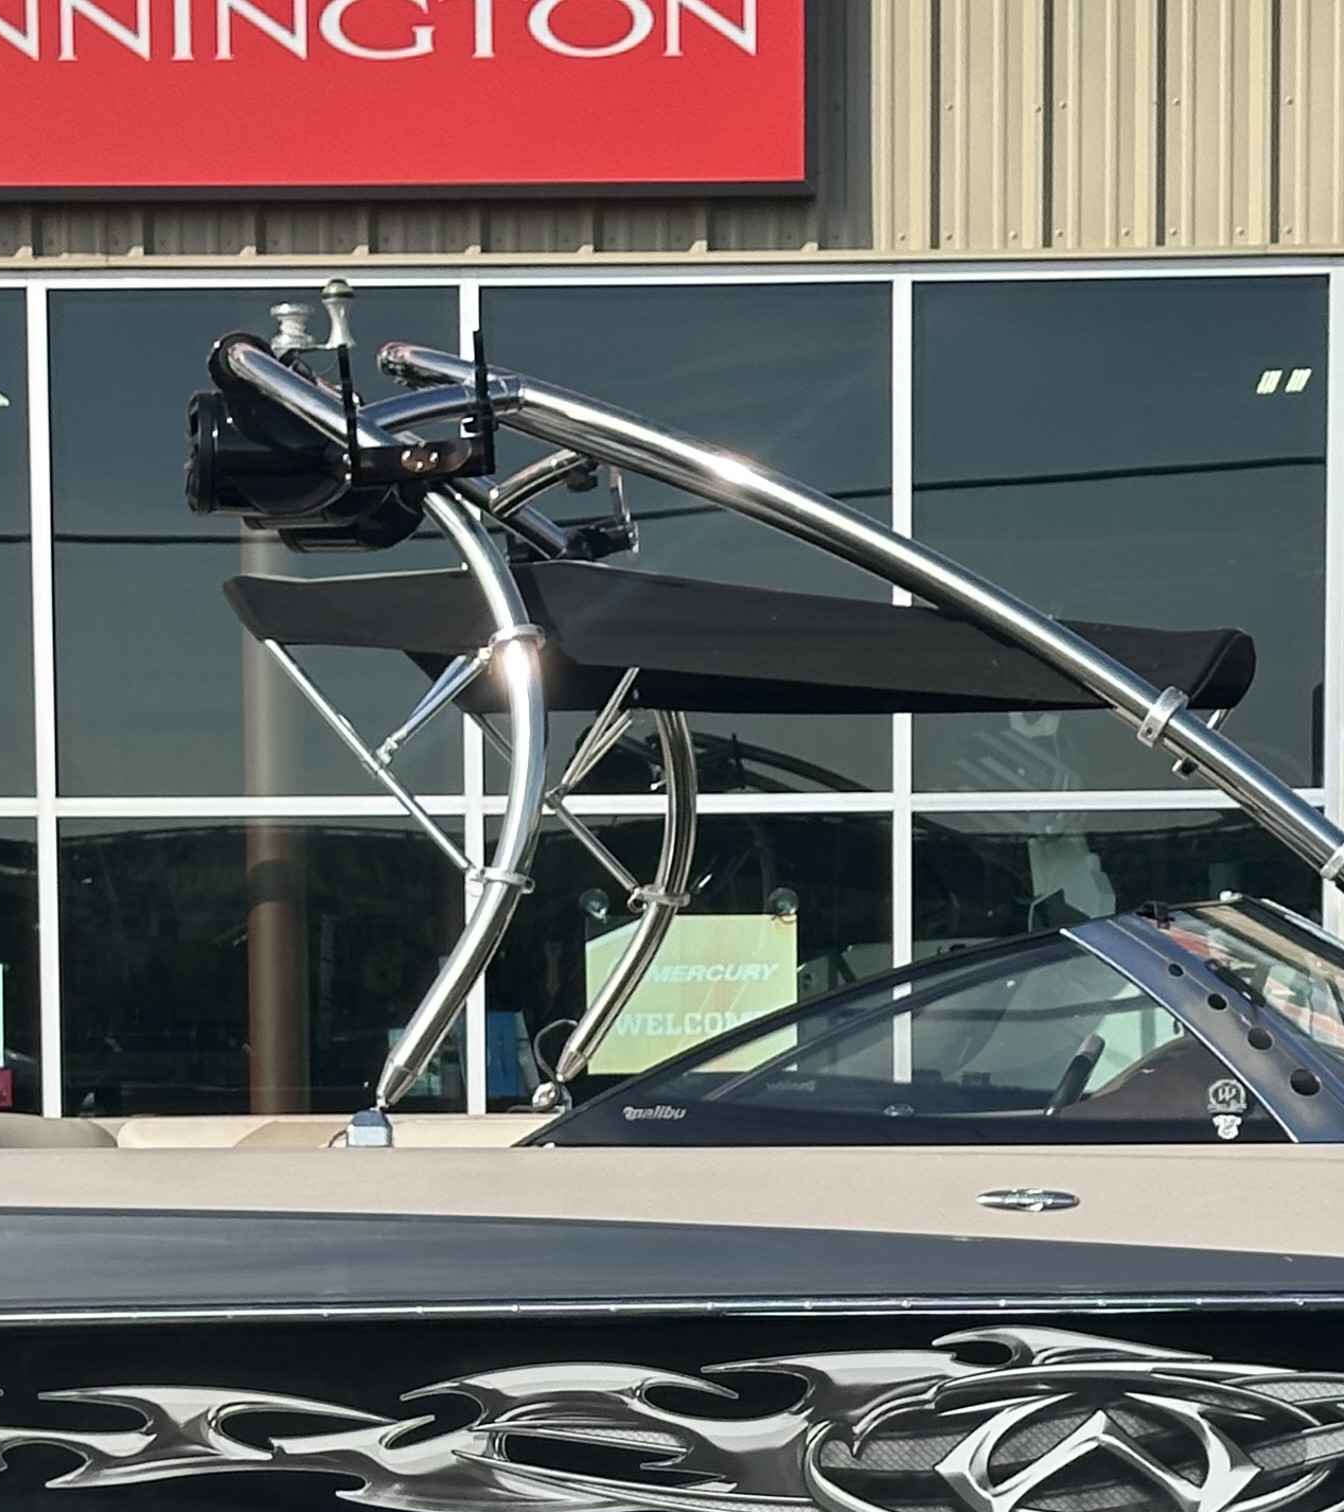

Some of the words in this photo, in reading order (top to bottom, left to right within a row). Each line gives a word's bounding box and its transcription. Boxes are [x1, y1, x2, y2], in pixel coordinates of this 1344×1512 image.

[648, 962, 780, 982] MERCURY
[614, 1010, 760, 1037] WELCOM
[623, 1105, 687, 1120] malibu
